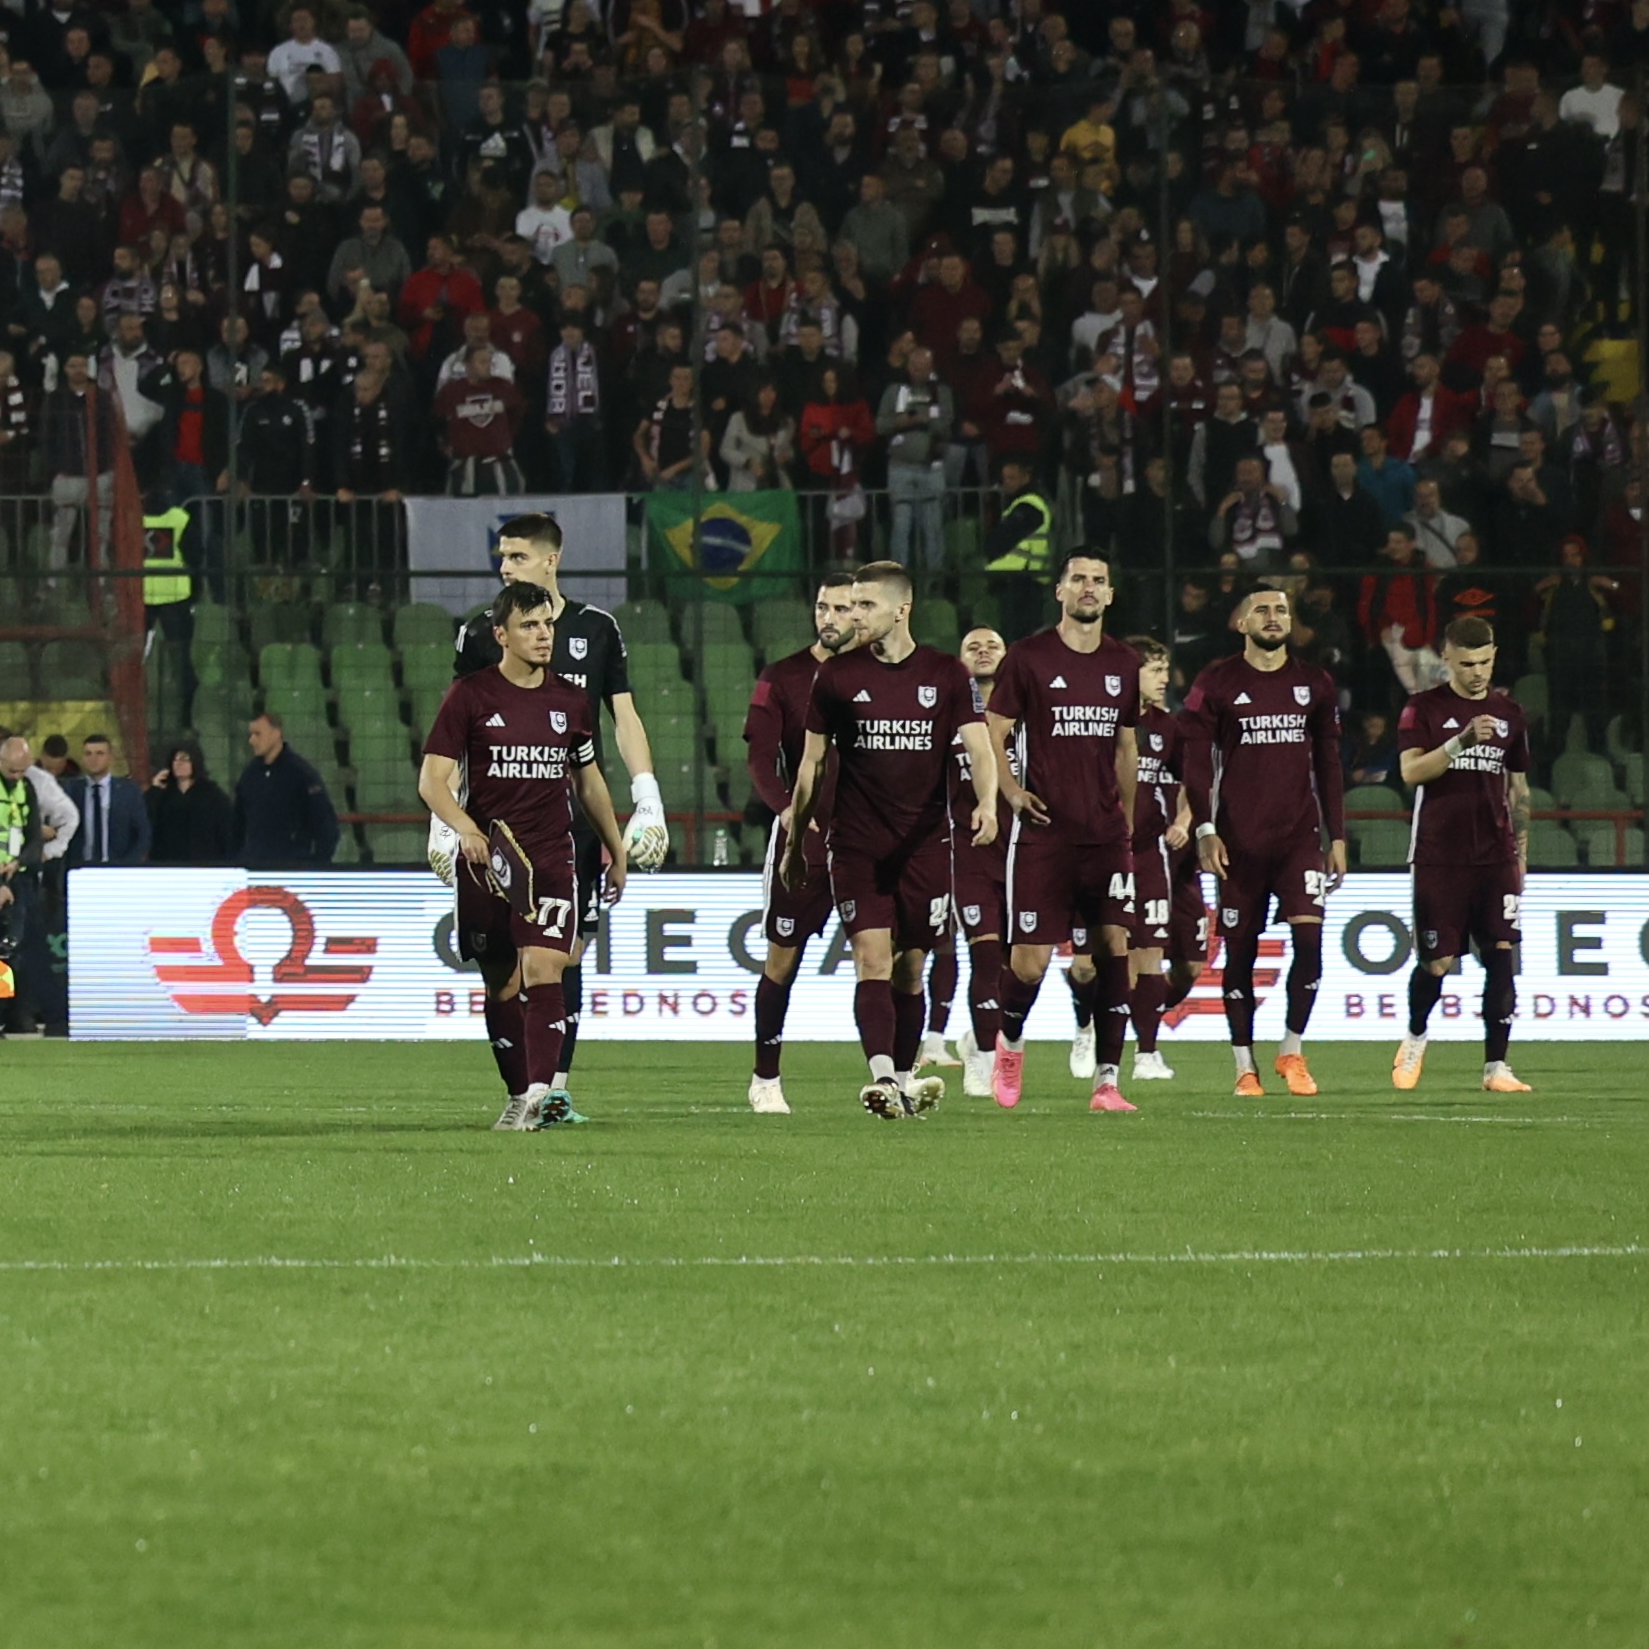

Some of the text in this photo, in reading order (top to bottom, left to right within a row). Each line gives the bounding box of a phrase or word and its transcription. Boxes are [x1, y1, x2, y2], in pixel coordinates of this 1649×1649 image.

[1051, 706, 1120, 722] TURKISH
[1238, 714, 1307, 730] TURKISH
[856, 720, 933, 735] TURKISH
[1051, 722, 1116, 737] AIRLINES
[853, 735, 933, 750] AIRLINES
[1240, 729, 1306, 745] AIRLINES
[489, 746, 568, 762] TURKISH
[1458, 744, 1505, 761] RKISH
[487, 762, 564, 779] AIRLINES
[1108, 872, 1135, 900] 44
[537, 897, 571, 928] 77
[1144, 899, 1169, 925] 18
